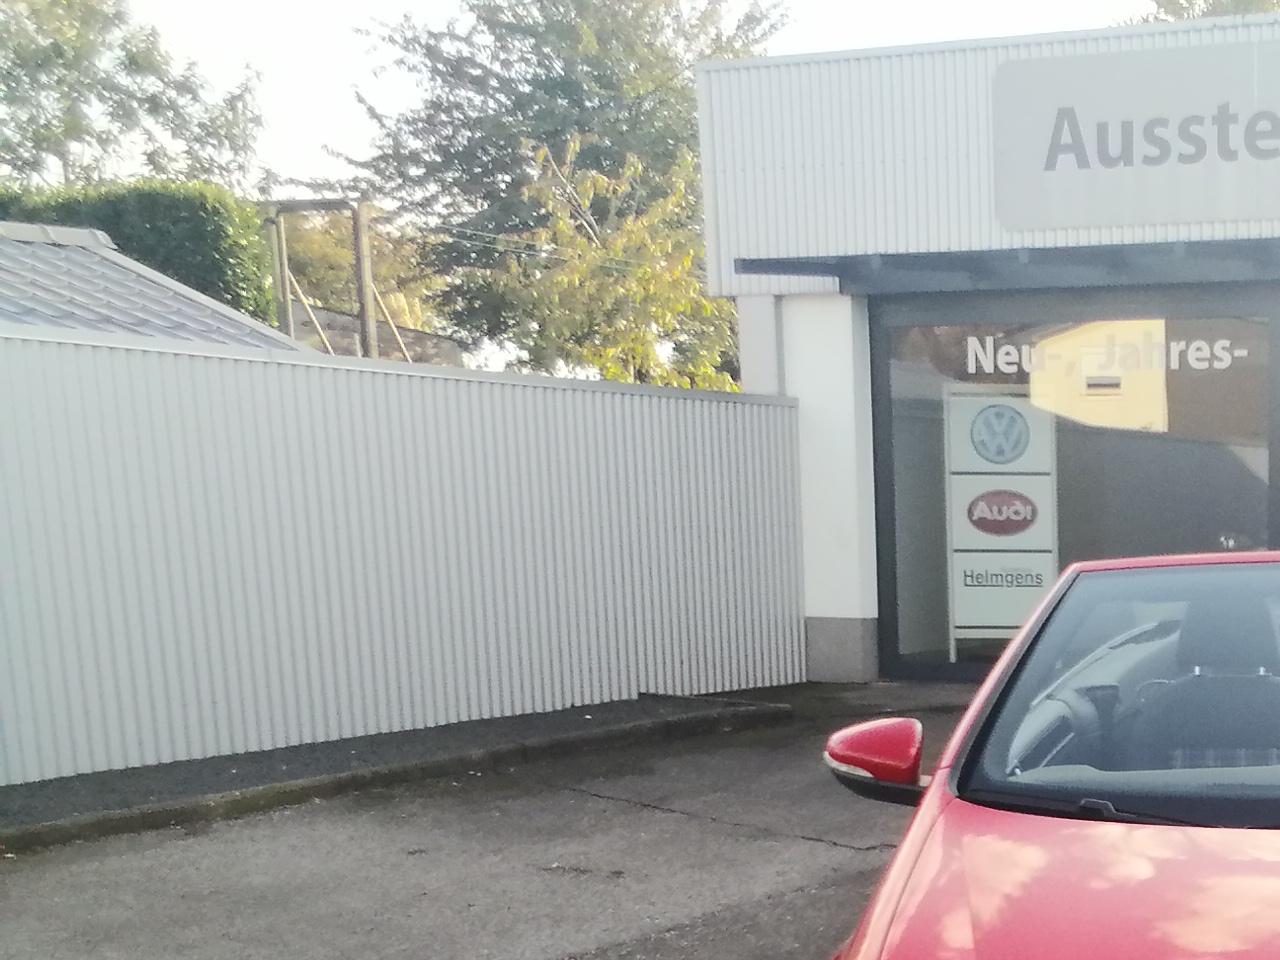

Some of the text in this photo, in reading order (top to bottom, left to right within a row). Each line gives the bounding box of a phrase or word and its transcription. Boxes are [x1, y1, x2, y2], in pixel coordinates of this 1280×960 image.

[1097, 330, 1249, 370] Jahres-
[972, 500, 1033, 522] Audi
[963, 569, 1043, 588] Helmgens
